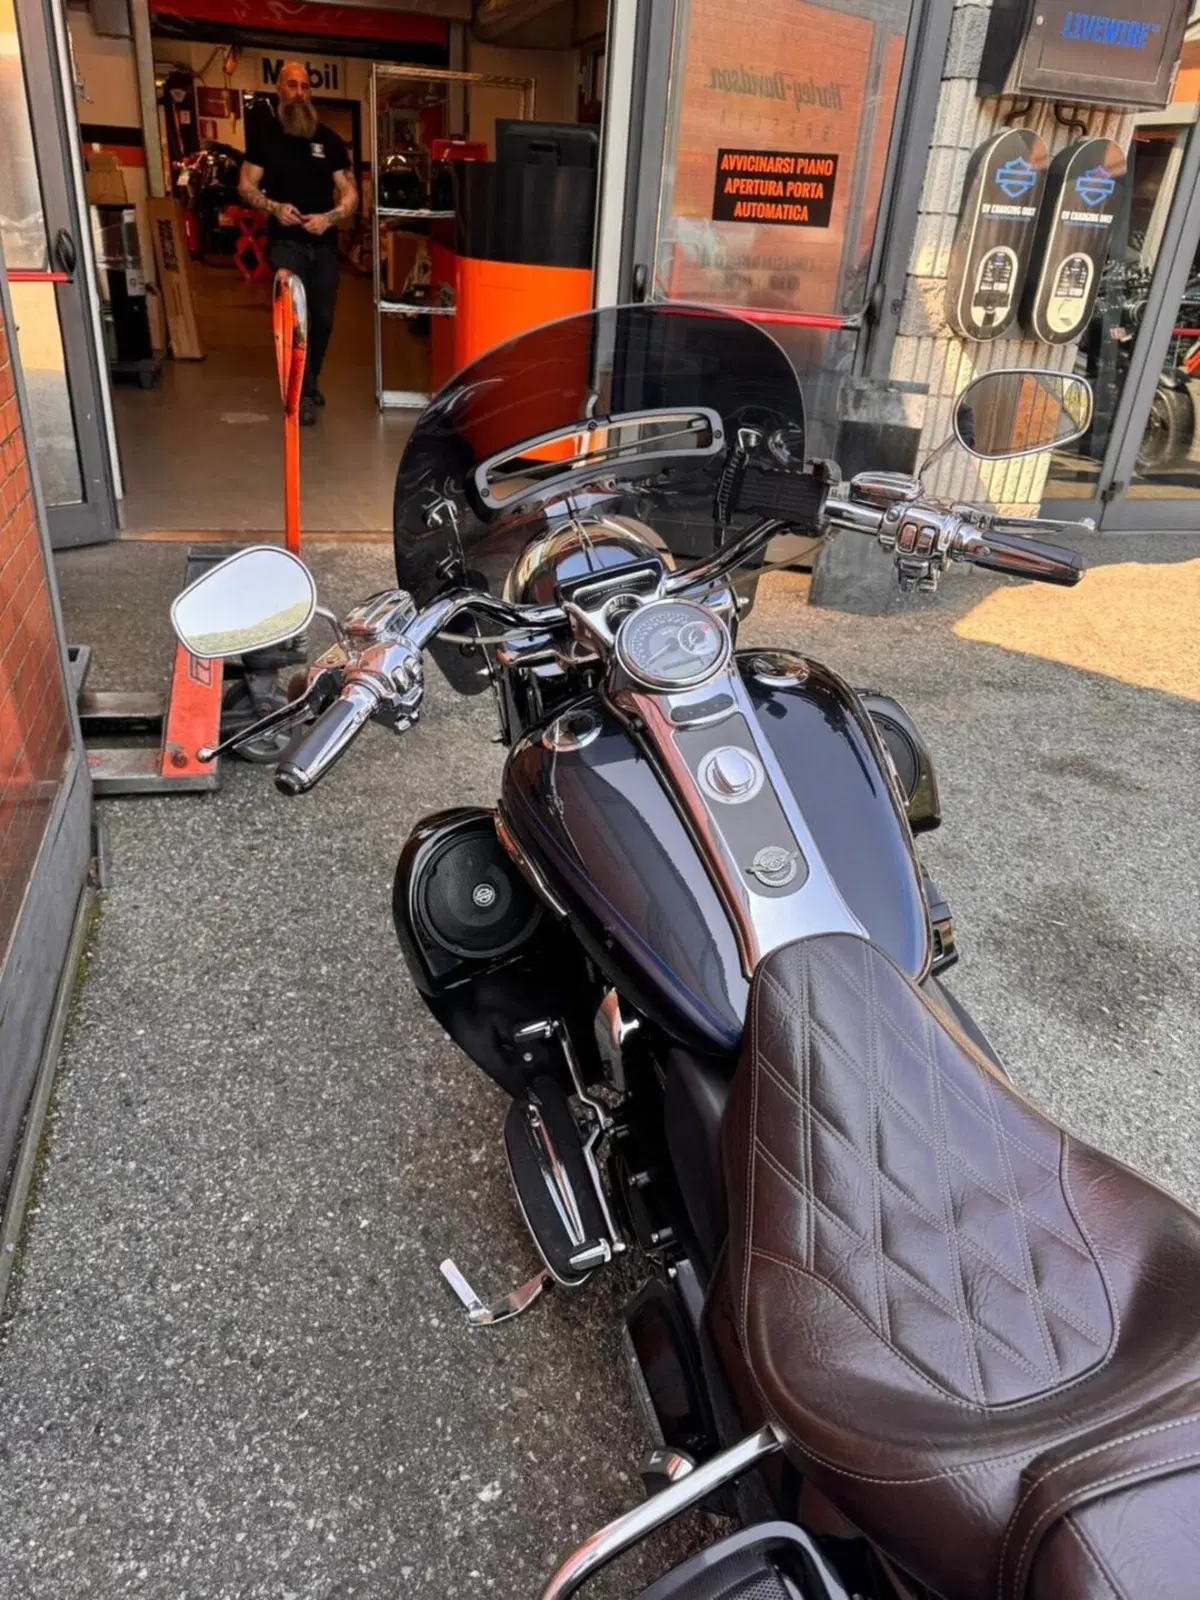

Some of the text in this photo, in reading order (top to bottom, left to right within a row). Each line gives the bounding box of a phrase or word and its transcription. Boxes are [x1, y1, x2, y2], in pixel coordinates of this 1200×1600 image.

[1062, 11, 1150, 49] LIVEWIRE
[262, 57, 339, 90] Mbil
[720, 154, 834, 176] AVVICINARSI PIANO
[724, 177, 824, 199] APERTURA PORTA
[733, 201, 808, 222] AUTOMATICA
